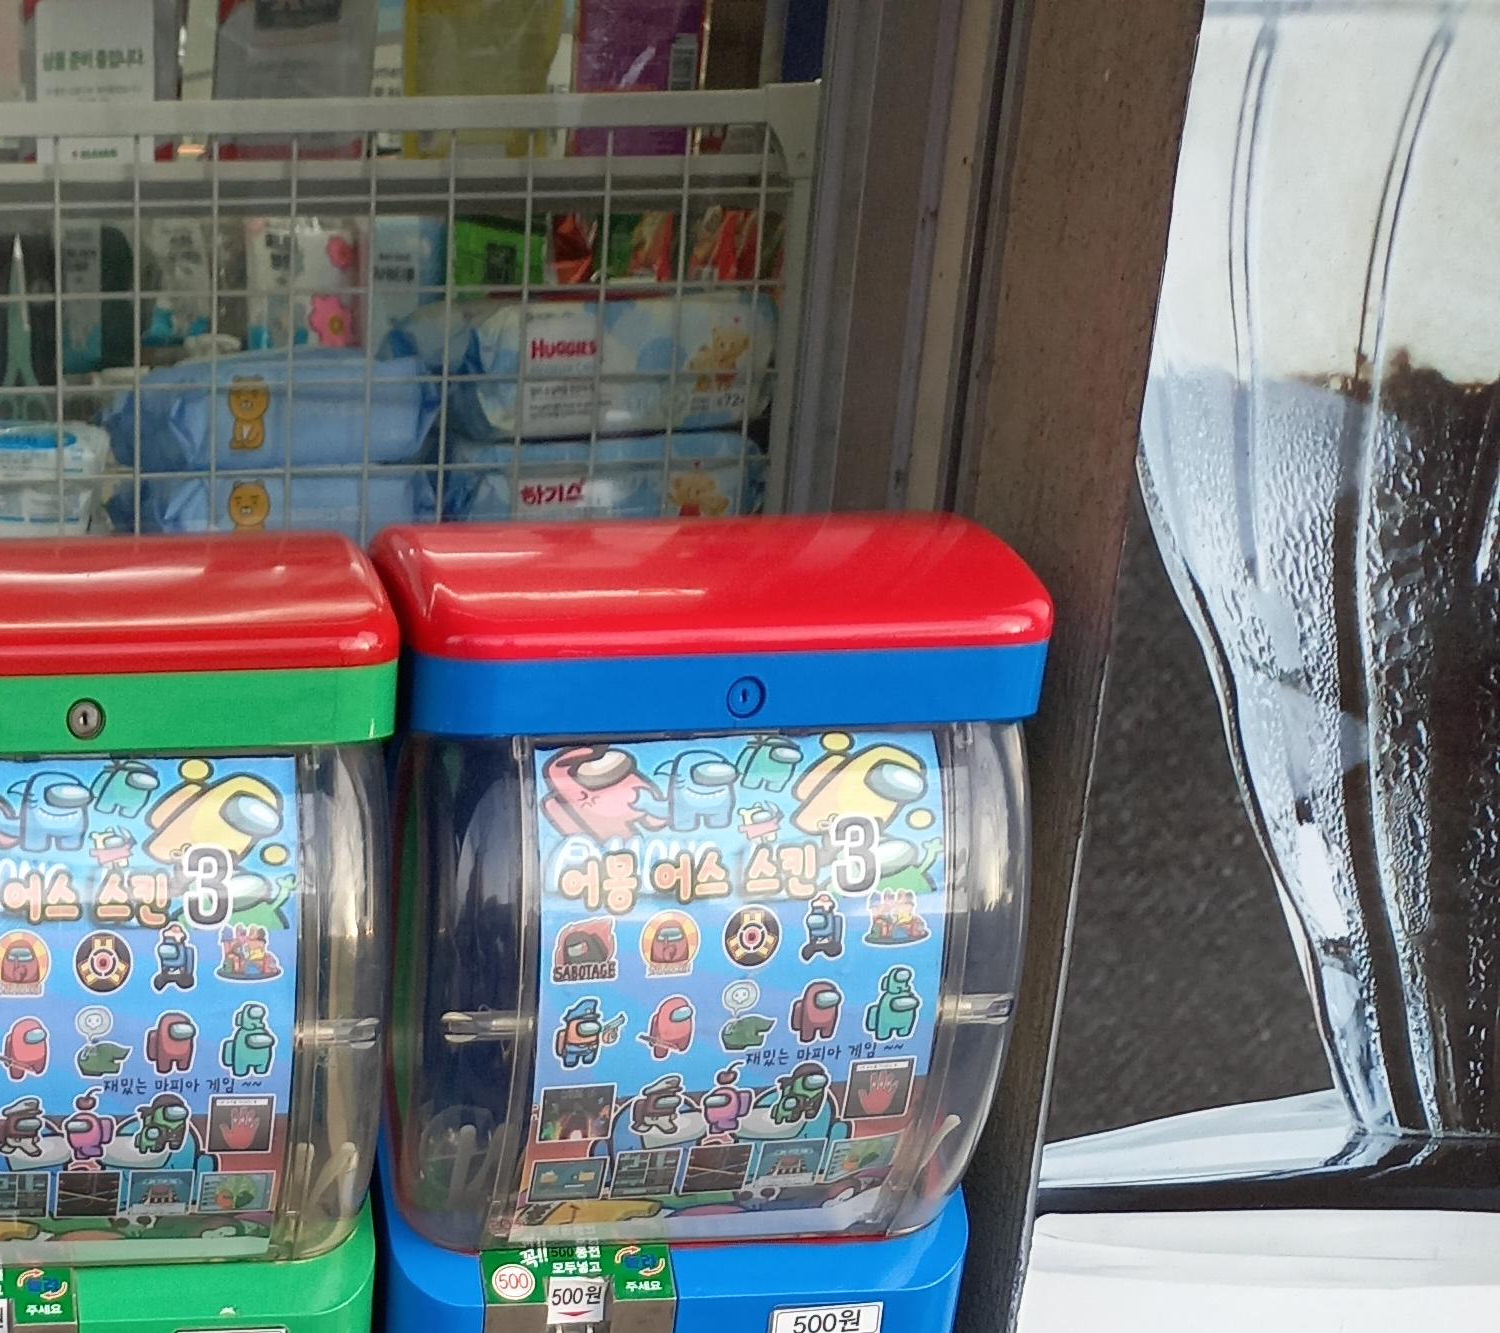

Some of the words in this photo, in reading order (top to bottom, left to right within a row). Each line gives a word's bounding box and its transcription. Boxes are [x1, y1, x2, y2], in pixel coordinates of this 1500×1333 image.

[559, 849, 639, 913] 어몽
[652, 849, 730, 903] 어스
[745, 841, 821, 900] 스킨
[830, 815, 881, 897] 3
[0, 868, 80, 927] 어스
[97, 867, 173, 929] 스킨
[183, 843, 235, 929] 3
[553, 961, 617, 982] SABOTAGE
[745, 1047, 790, 1067] 재밌는
[796, 1044, 842, 1061] 마피아
[848, 1041, 877, 1059] 게임
[103, 1077, 148, 1096] 재밌는
[154, 1077, 200, 1093] 마피아
[206, 1076, 235, 1094] 게임
[499, 1272, 530, 1290] 500
[625, 1280, 663, 1293] 주세요
[551, 1284, 602, 1306] 500원
[25, 1303, 63, 1317] 주세요
